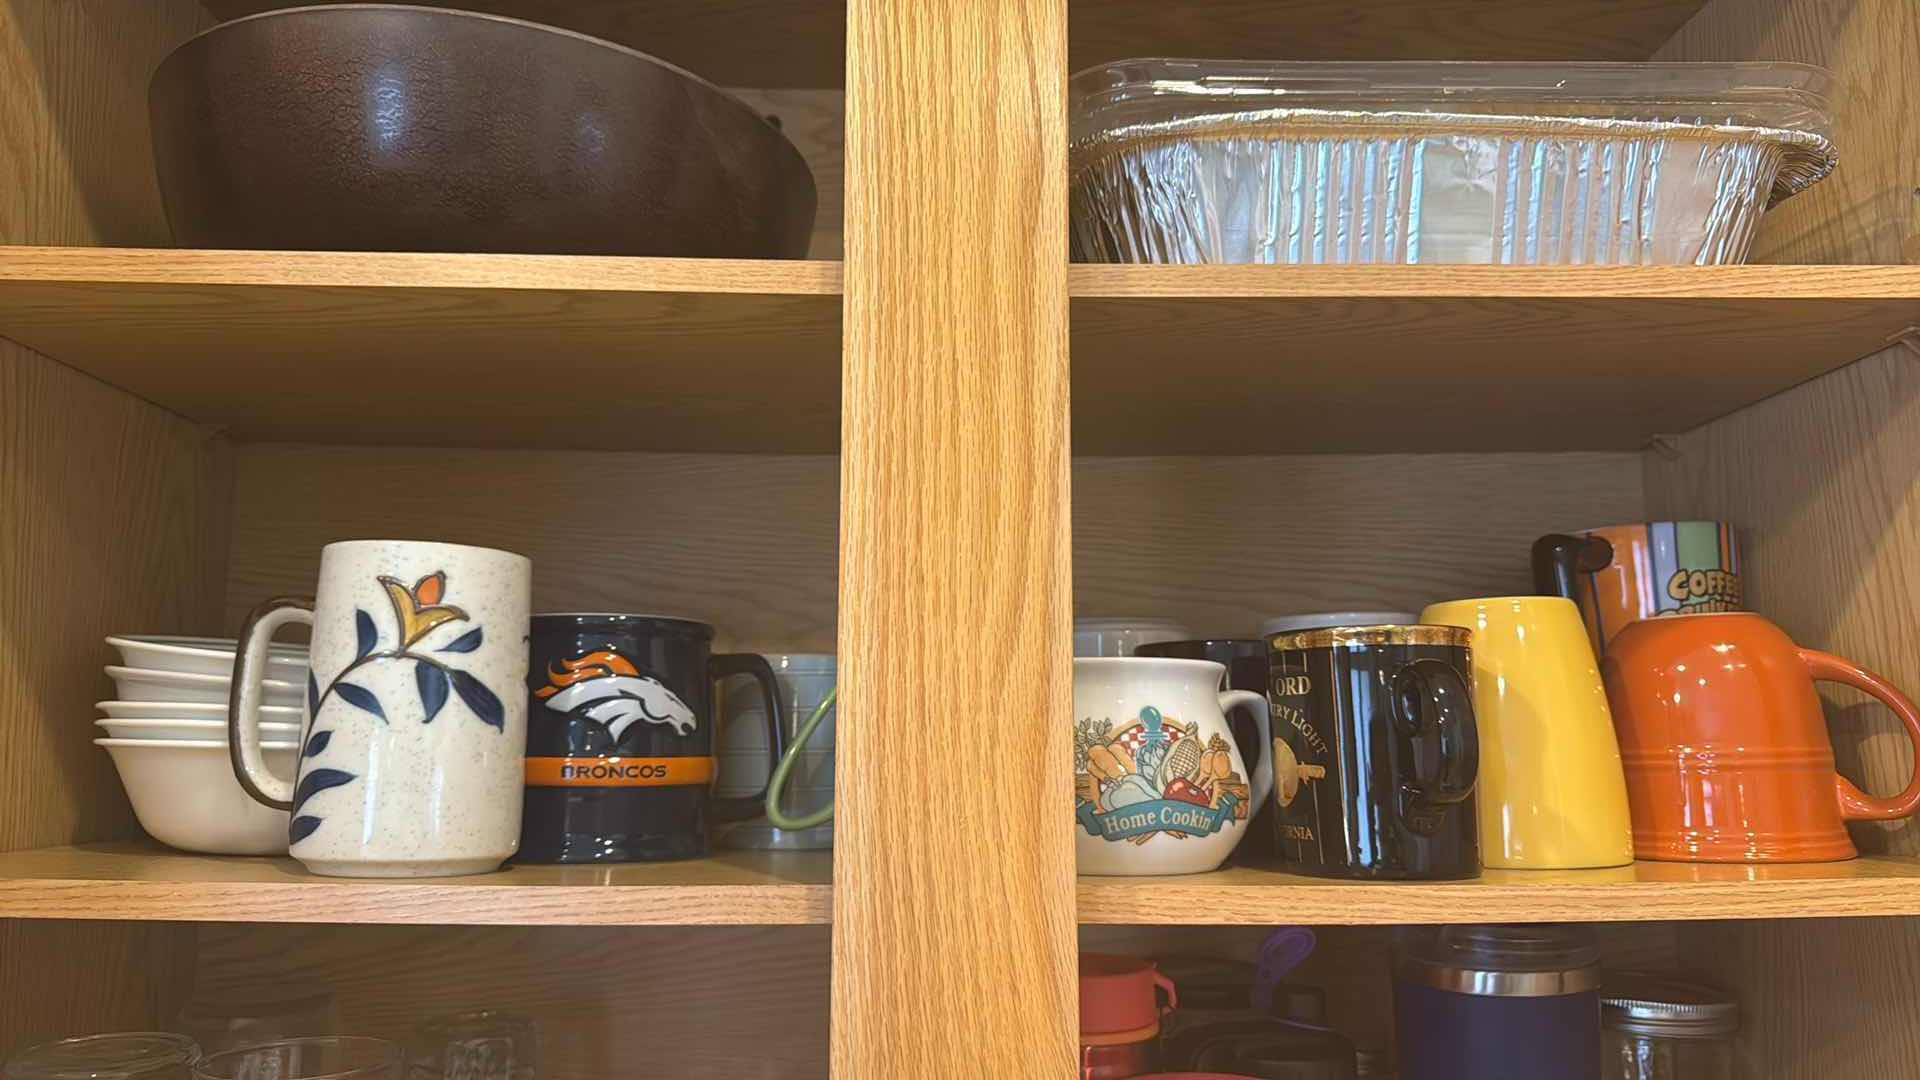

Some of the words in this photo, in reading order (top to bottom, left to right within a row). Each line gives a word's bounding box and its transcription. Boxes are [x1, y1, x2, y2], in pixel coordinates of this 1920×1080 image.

[1291, 709, 1329, 753] LIGHT
[560, 765, 667, 779] BRONCOS
[1104, 811, 1157, 834] Home
